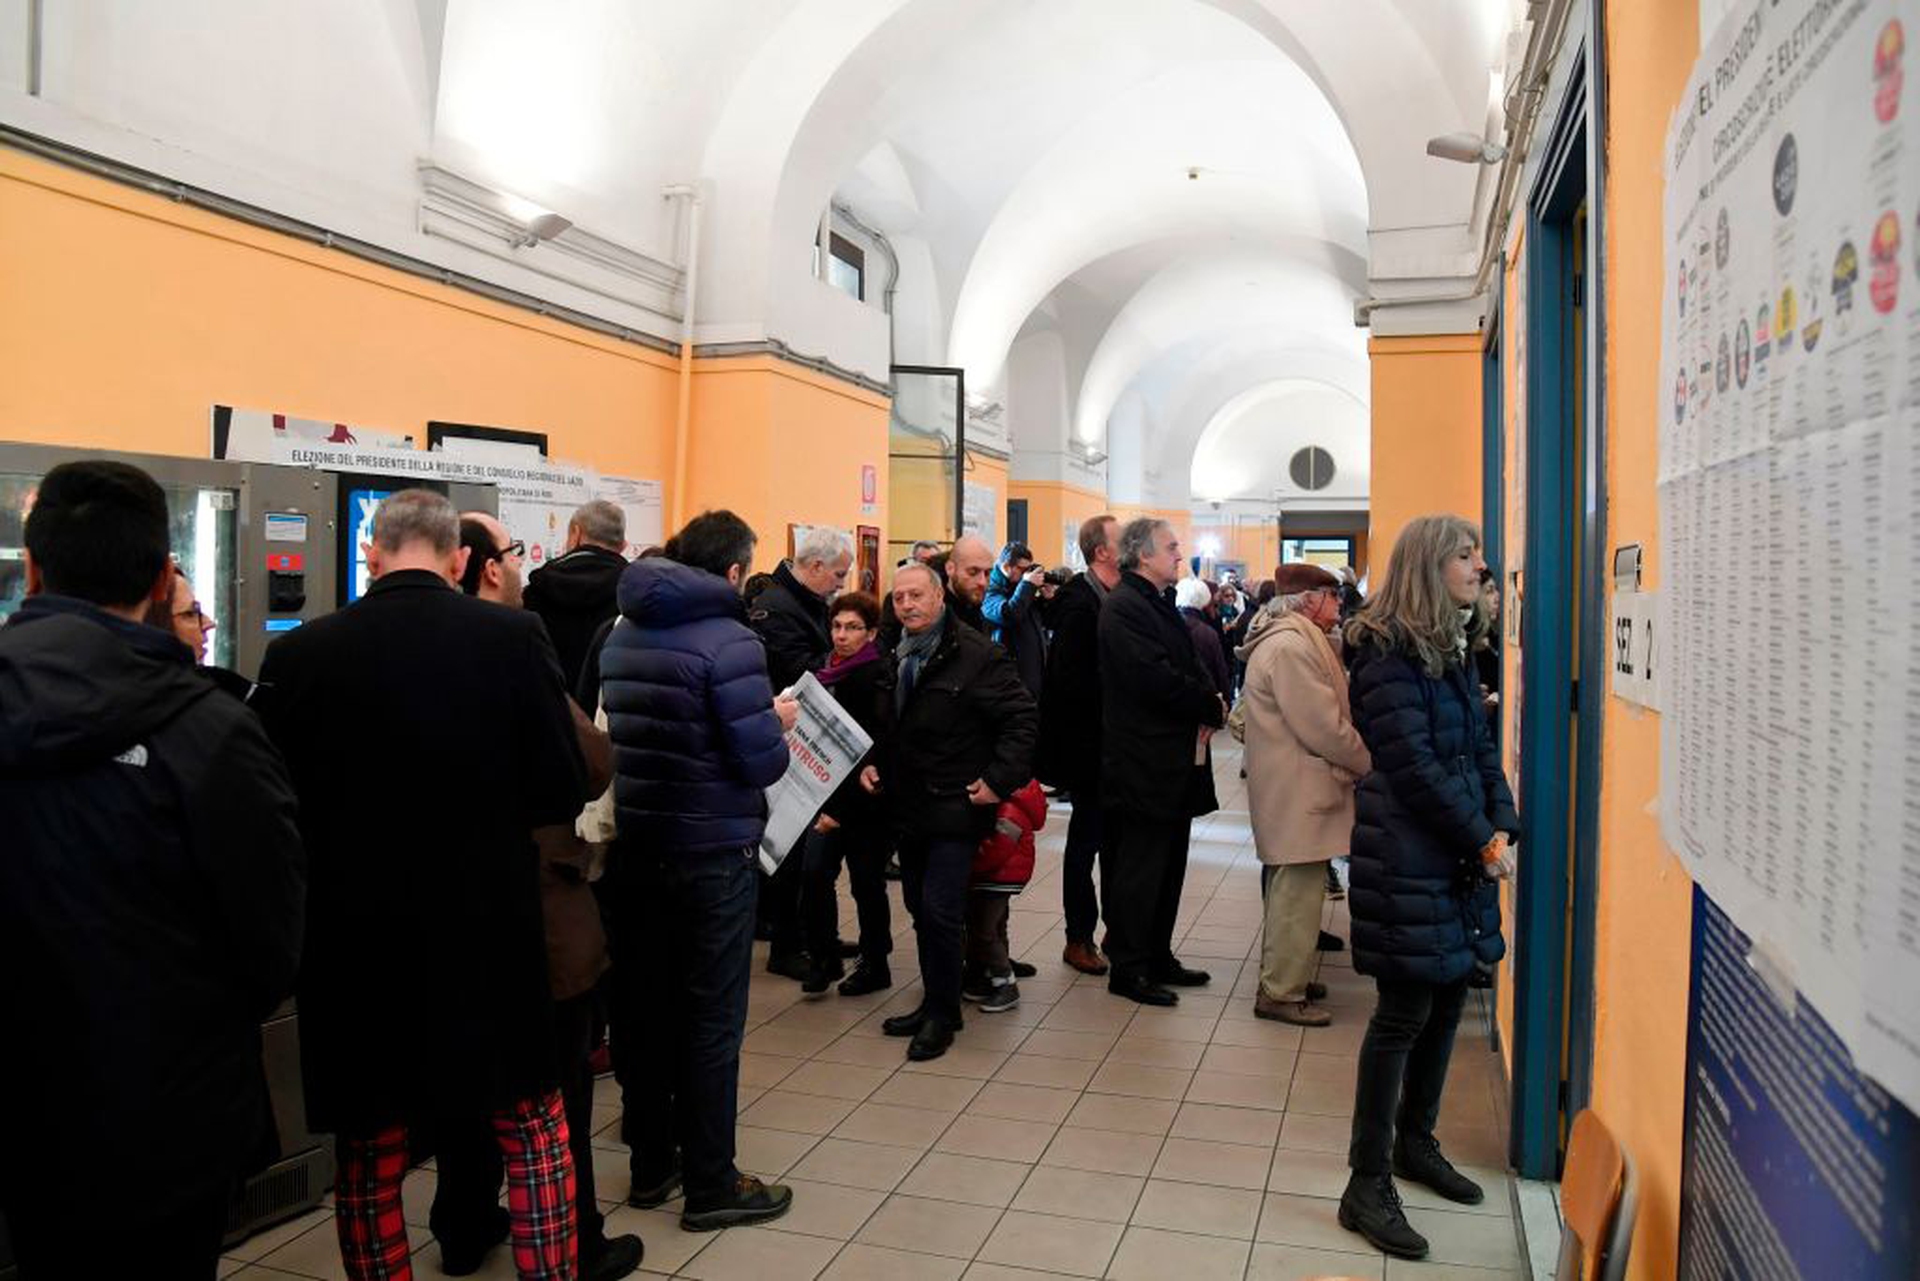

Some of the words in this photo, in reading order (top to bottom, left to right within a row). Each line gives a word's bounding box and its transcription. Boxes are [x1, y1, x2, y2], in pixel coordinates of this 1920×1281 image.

[291, 449, 336, 464] ELEZIONE
[338, 453, 354, 466] DEL
[355, 454, 406, 470] PRESIDENTE
